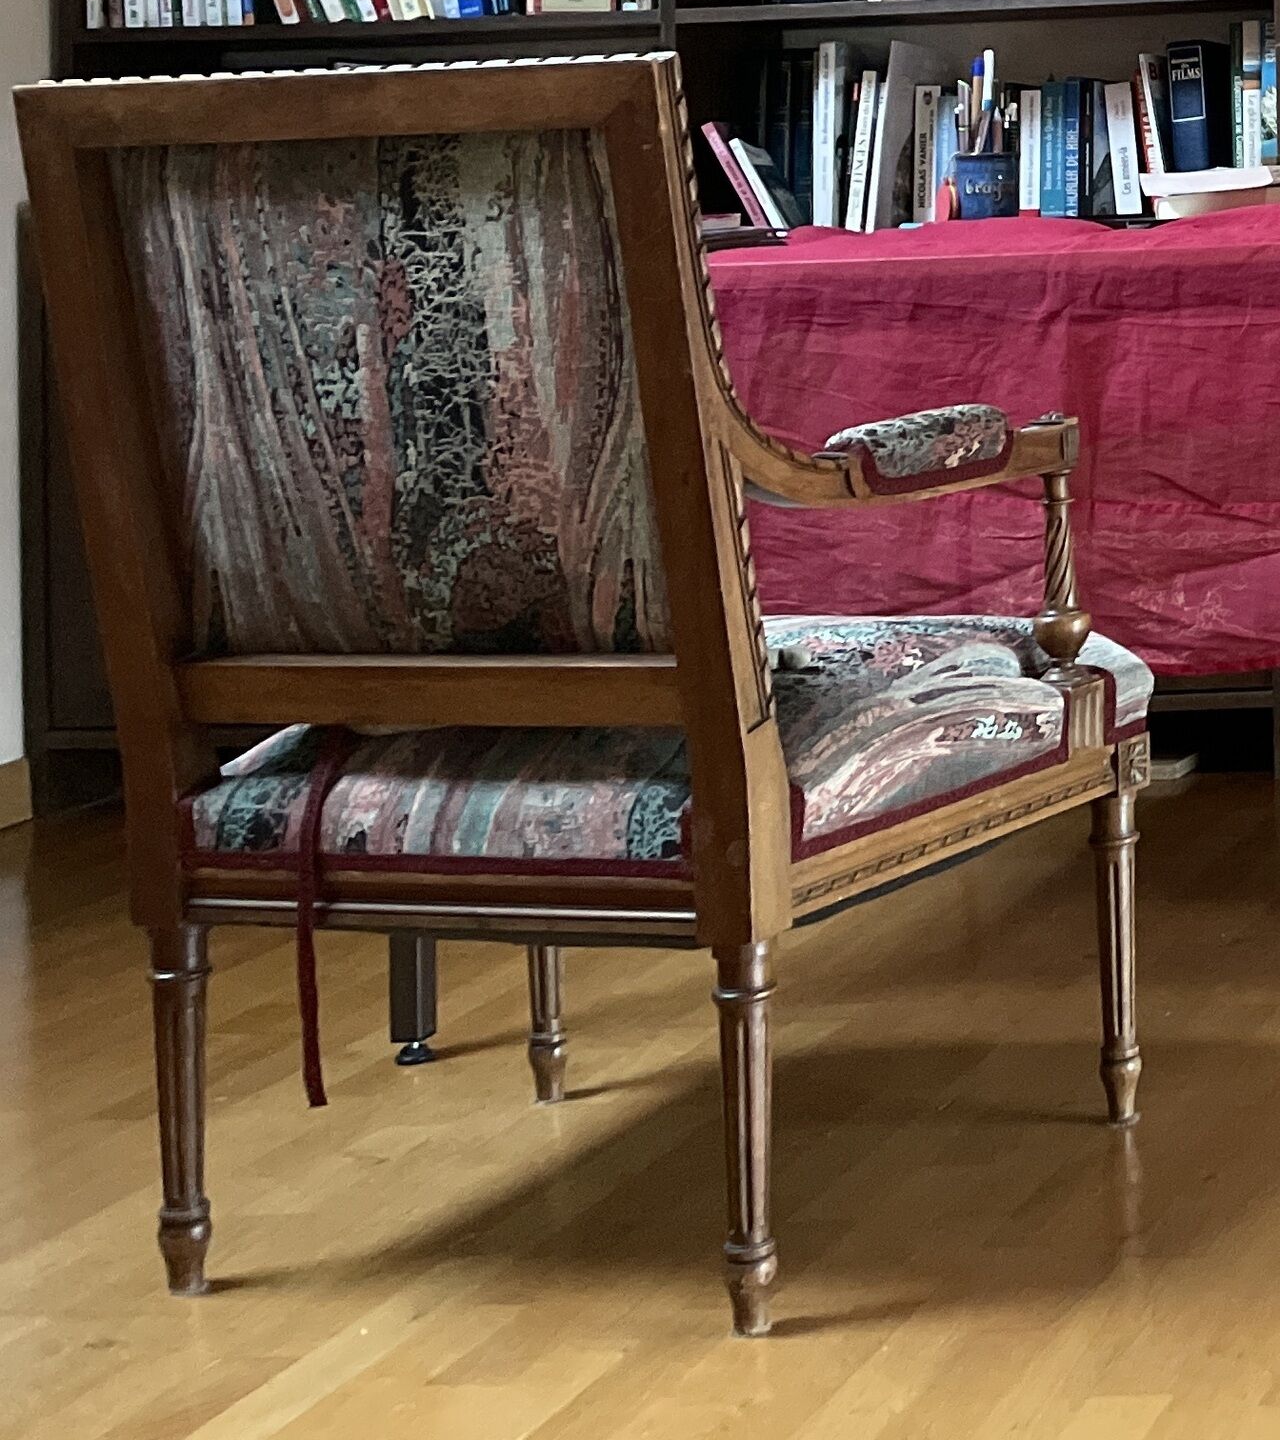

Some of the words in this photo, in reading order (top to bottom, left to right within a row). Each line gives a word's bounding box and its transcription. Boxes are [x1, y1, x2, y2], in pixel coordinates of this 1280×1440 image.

[1171, 67, 1202, 81] FILMS
[1246, 108, 1257, 129] globe
[918, 132, 927, 165] VANIER
[1065, 155, 1078, 172] DE
[916, 169, 927, 210] NICOLAS
[1121, 175, 1132, 195] Ces
